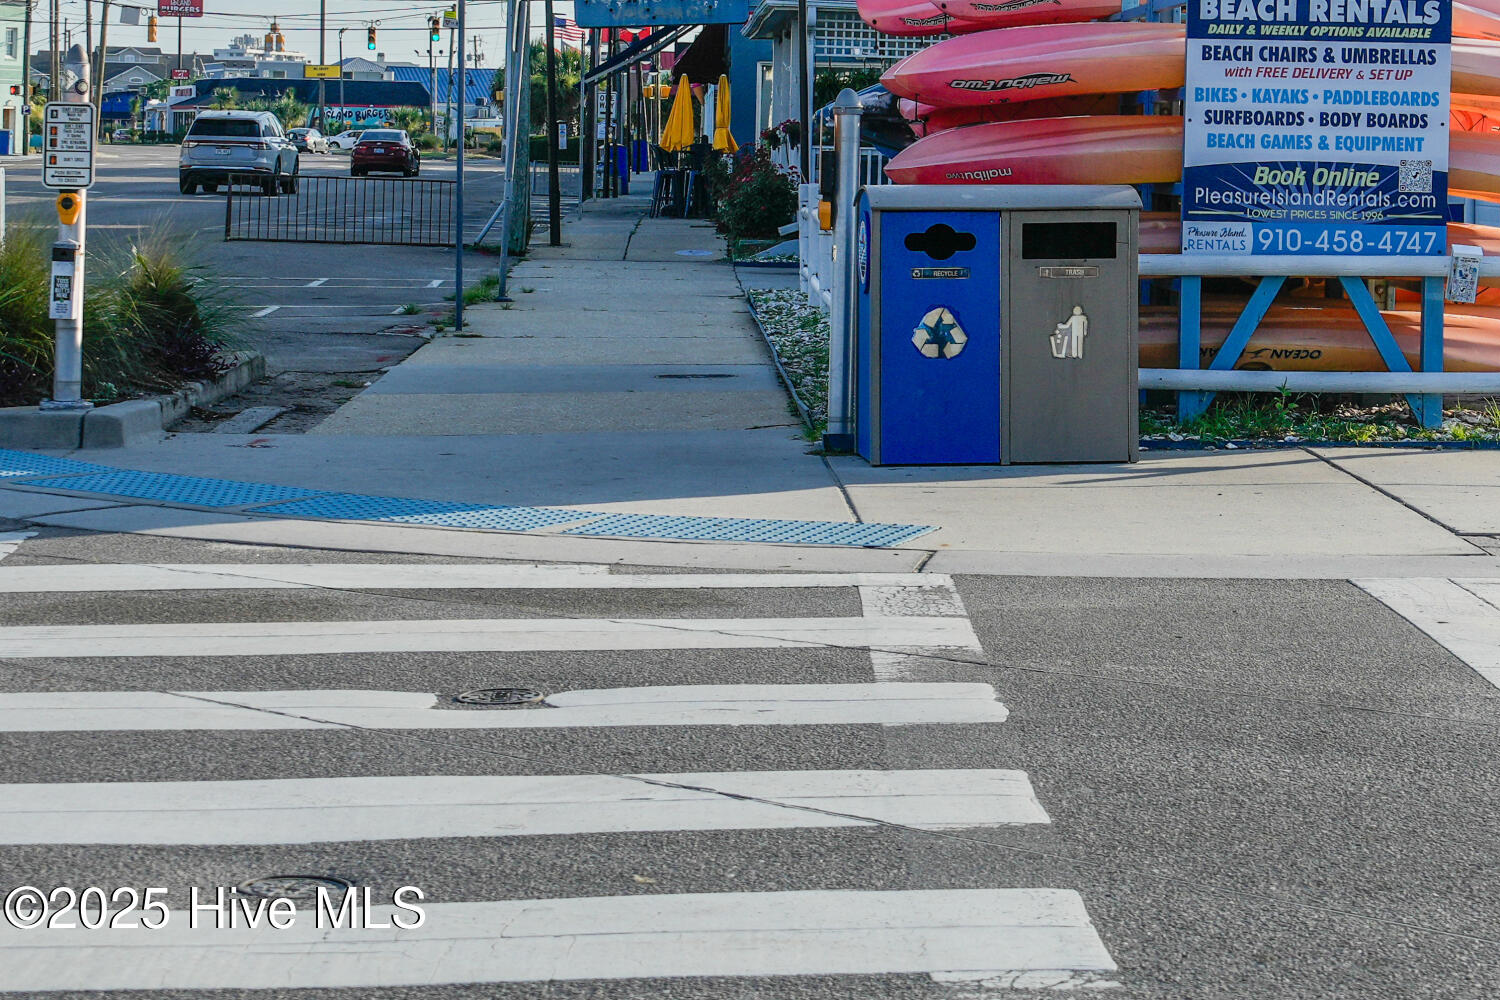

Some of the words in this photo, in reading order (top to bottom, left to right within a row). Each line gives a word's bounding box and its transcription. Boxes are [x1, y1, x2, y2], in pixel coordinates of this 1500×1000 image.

[1208, 23, 1244, 35] DAILY
[1246, 25, 1256, 35] &
[1260, 25, 1309, 36] WEEKLY
[1310, 26, 1365, 37] OPTIONS
[1366, 27, 1432, 39] AVAILABLE
[1201, 45, 1253, 62] BEACH
[1259, 46, 1318, 63] CHAIRS
[1323, 47, 1335, 63] &
[1341, 48, 1437, 66] UMBRELLAS
[1224, 66, 1252, 78] with
[1256, 67, 1289, 78] FREE
[1292, 68, 1353, 80] DELIVERY
[1356, 70, 1365, 80] &
[1194, 87, 1238, 103] BIKES
[1252, 88, 1309, 104] KAYAKS
[1324, 89, 1440, 107] PADDLEBOARDS
[1204, 110, 1305, 127] SURFBOARDS
[1319, 112, 1362, 128] BODY
[1366, 113, 1428, 129] BOARDS
[1206, 132, 1255, 150] BEACH
[1260, 134, 1313, 150] GAMES
[1317, 135, 1330, 150] &
[1335, 135, 1425, 153] EQUIPMENT
[1253, 166, 1307, 186] Book
[1312, 167, 1380, 187] Online
[1195, 187, 1436, 208] PleasureIslandRentals.com
[1247, 208, 1289, 219] LOWEST
[1290, 209, 1327, 220] PRICES
[1330, 211, 1358, 220] SINCE
[1361, 211, 1384, 220] 1996
[1188, 239, 1246, 251] RENTALS
[1259, 228, 1436, 253] 910-458-4747
[1270, 349, 1322, 359] OCEAN
